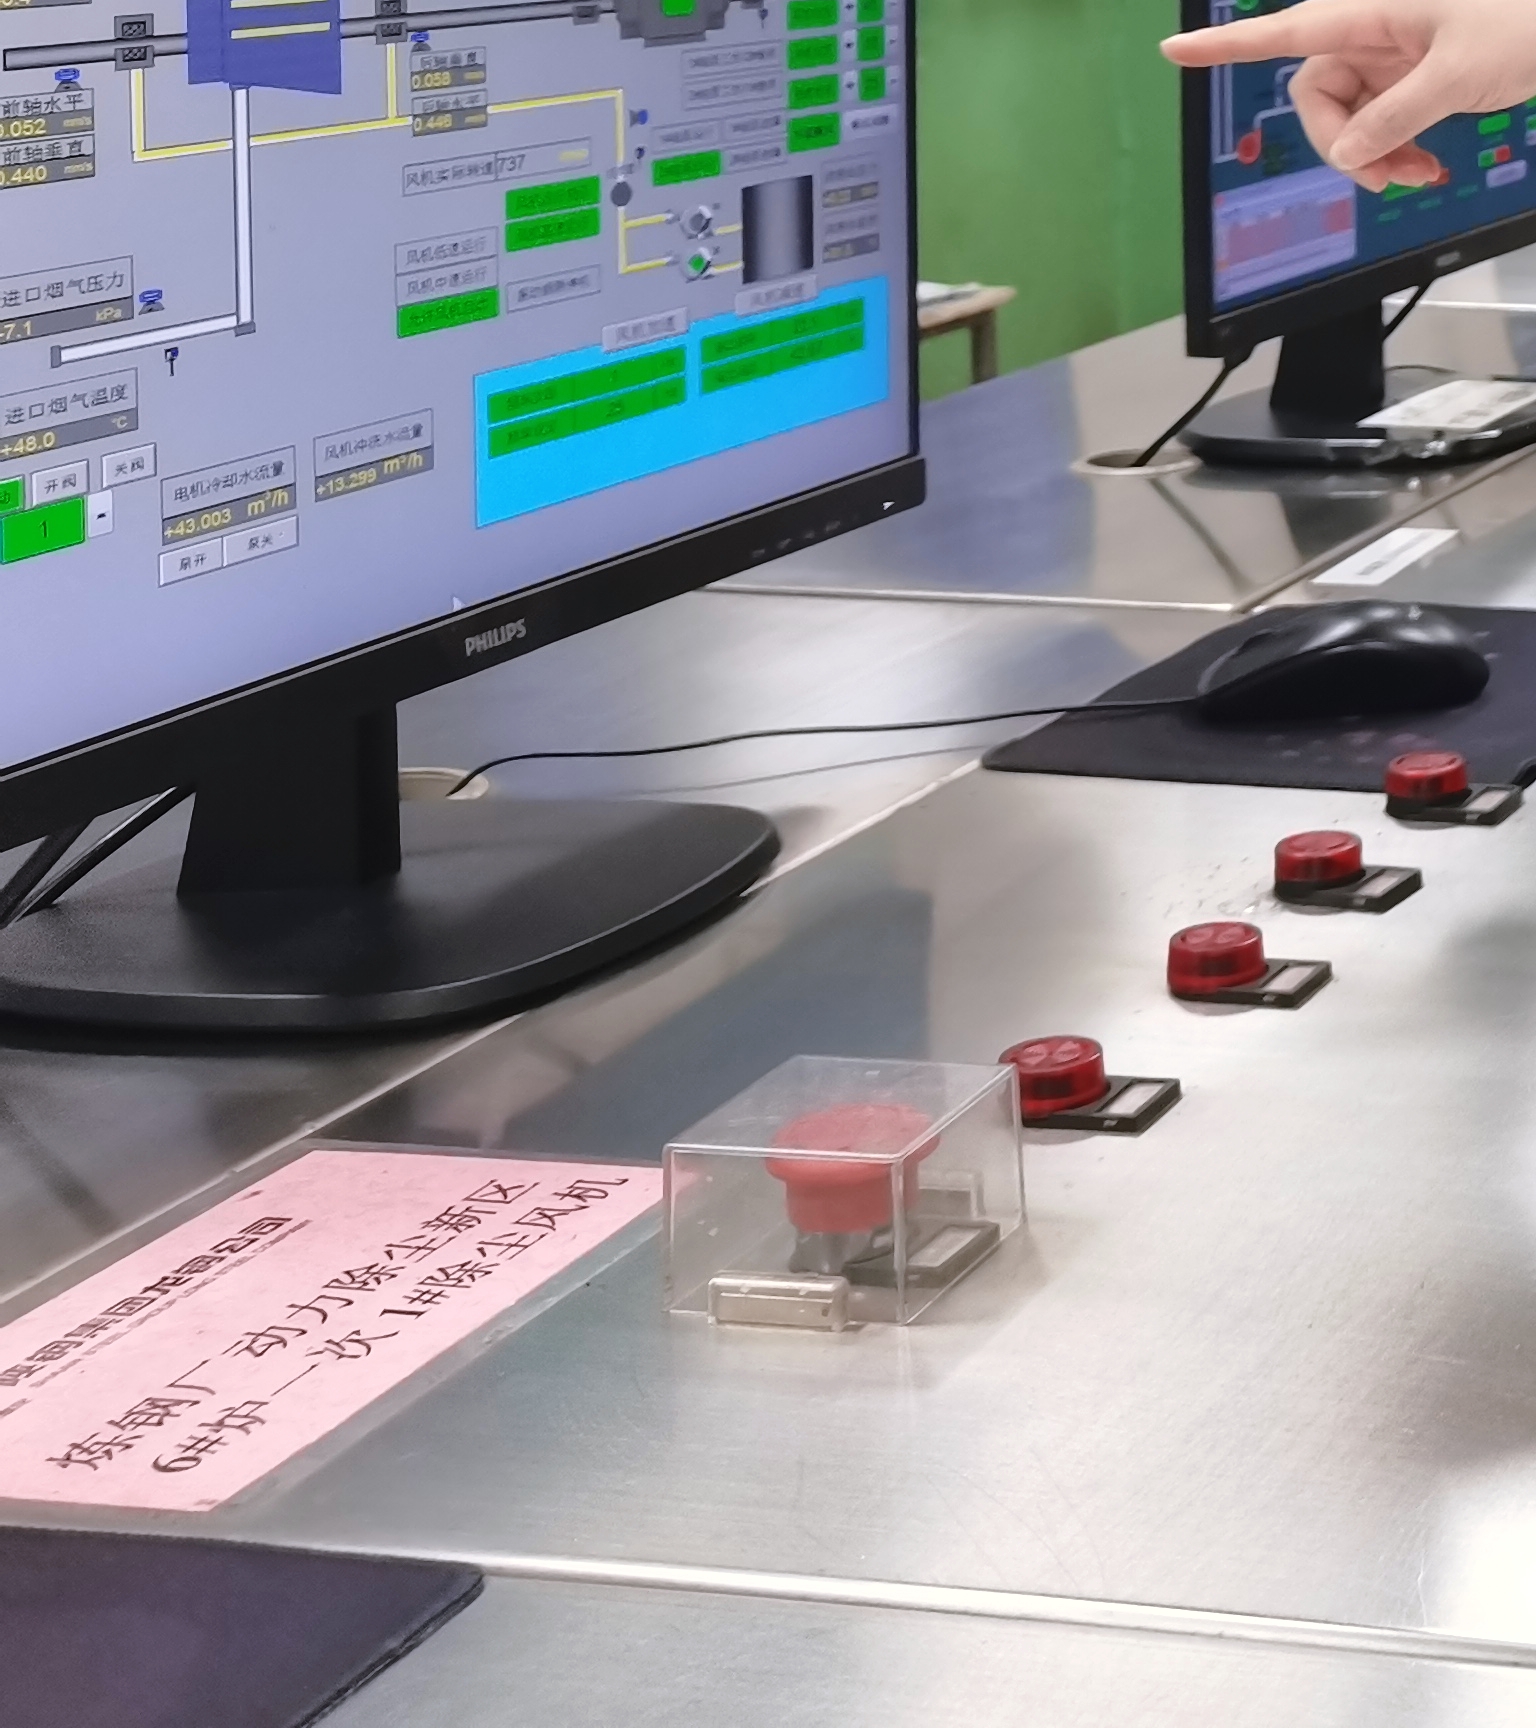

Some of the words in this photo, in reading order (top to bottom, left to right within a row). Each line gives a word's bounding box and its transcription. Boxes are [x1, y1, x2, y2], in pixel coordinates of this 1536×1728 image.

[2, 92, 84, 118] 前轴水平
[2, 271, 124, 308] 进口烟气压力
[96, 307, 122, 322] kPa
[5, 383, 128, 425] 进口烟气温度
[1, 431, 55, 456] +48.0
[44, 473, 76, 494] 开阀
[174, 460, 284, 503] 电机冷却水流量
[164, 508, 231, 538] +43.003
[465, 618, 527, 657] PHILIPS
